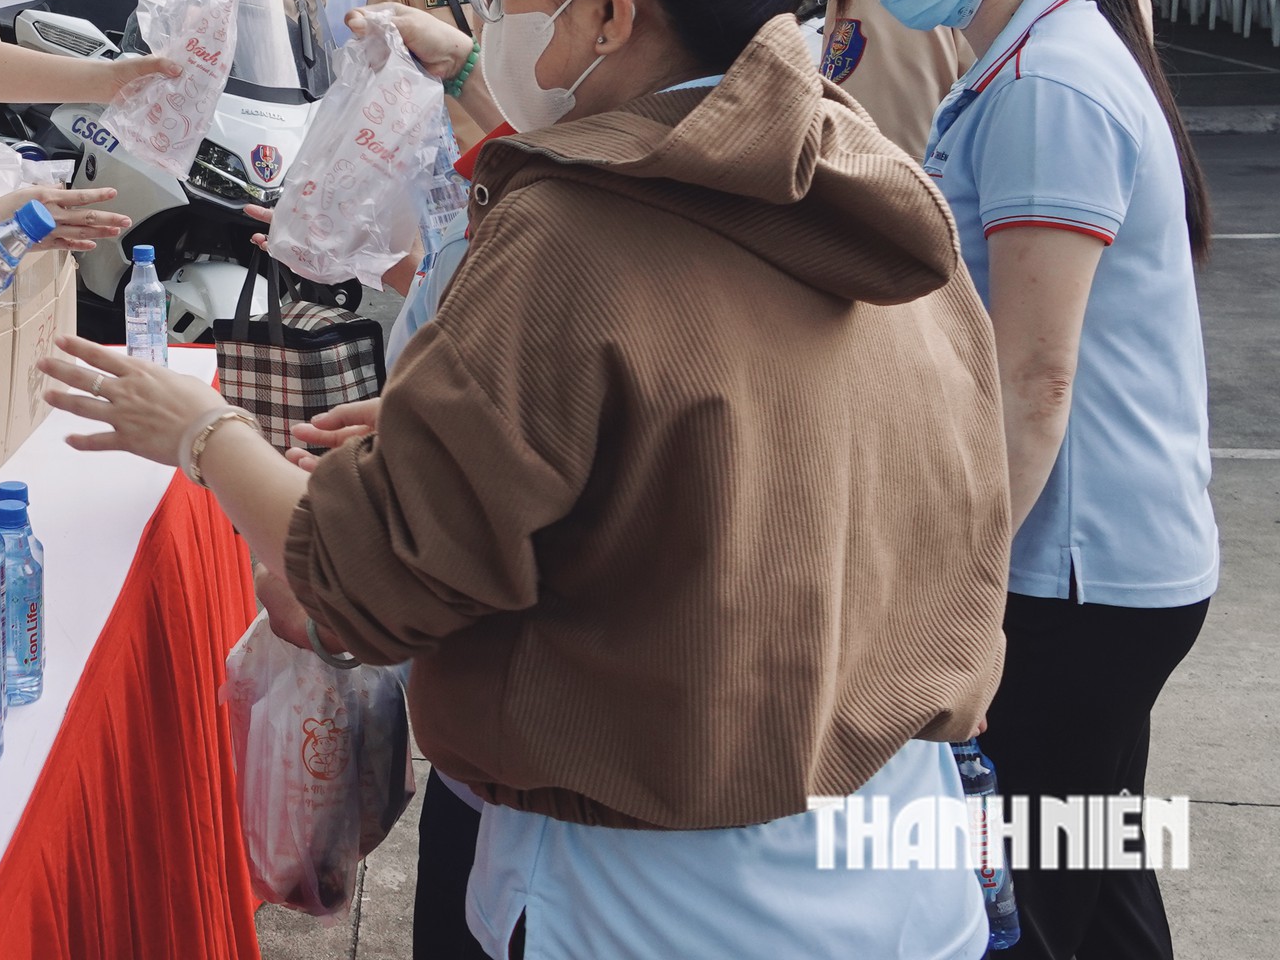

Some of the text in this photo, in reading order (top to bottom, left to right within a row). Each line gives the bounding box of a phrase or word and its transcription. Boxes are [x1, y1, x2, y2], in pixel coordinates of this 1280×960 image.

[185, 37, 221, 65] Bánh
[241, 108, 285, 121] HONDA
[354, 128, 400, 164] Bánh
[26, 602, 38, 632] Life
